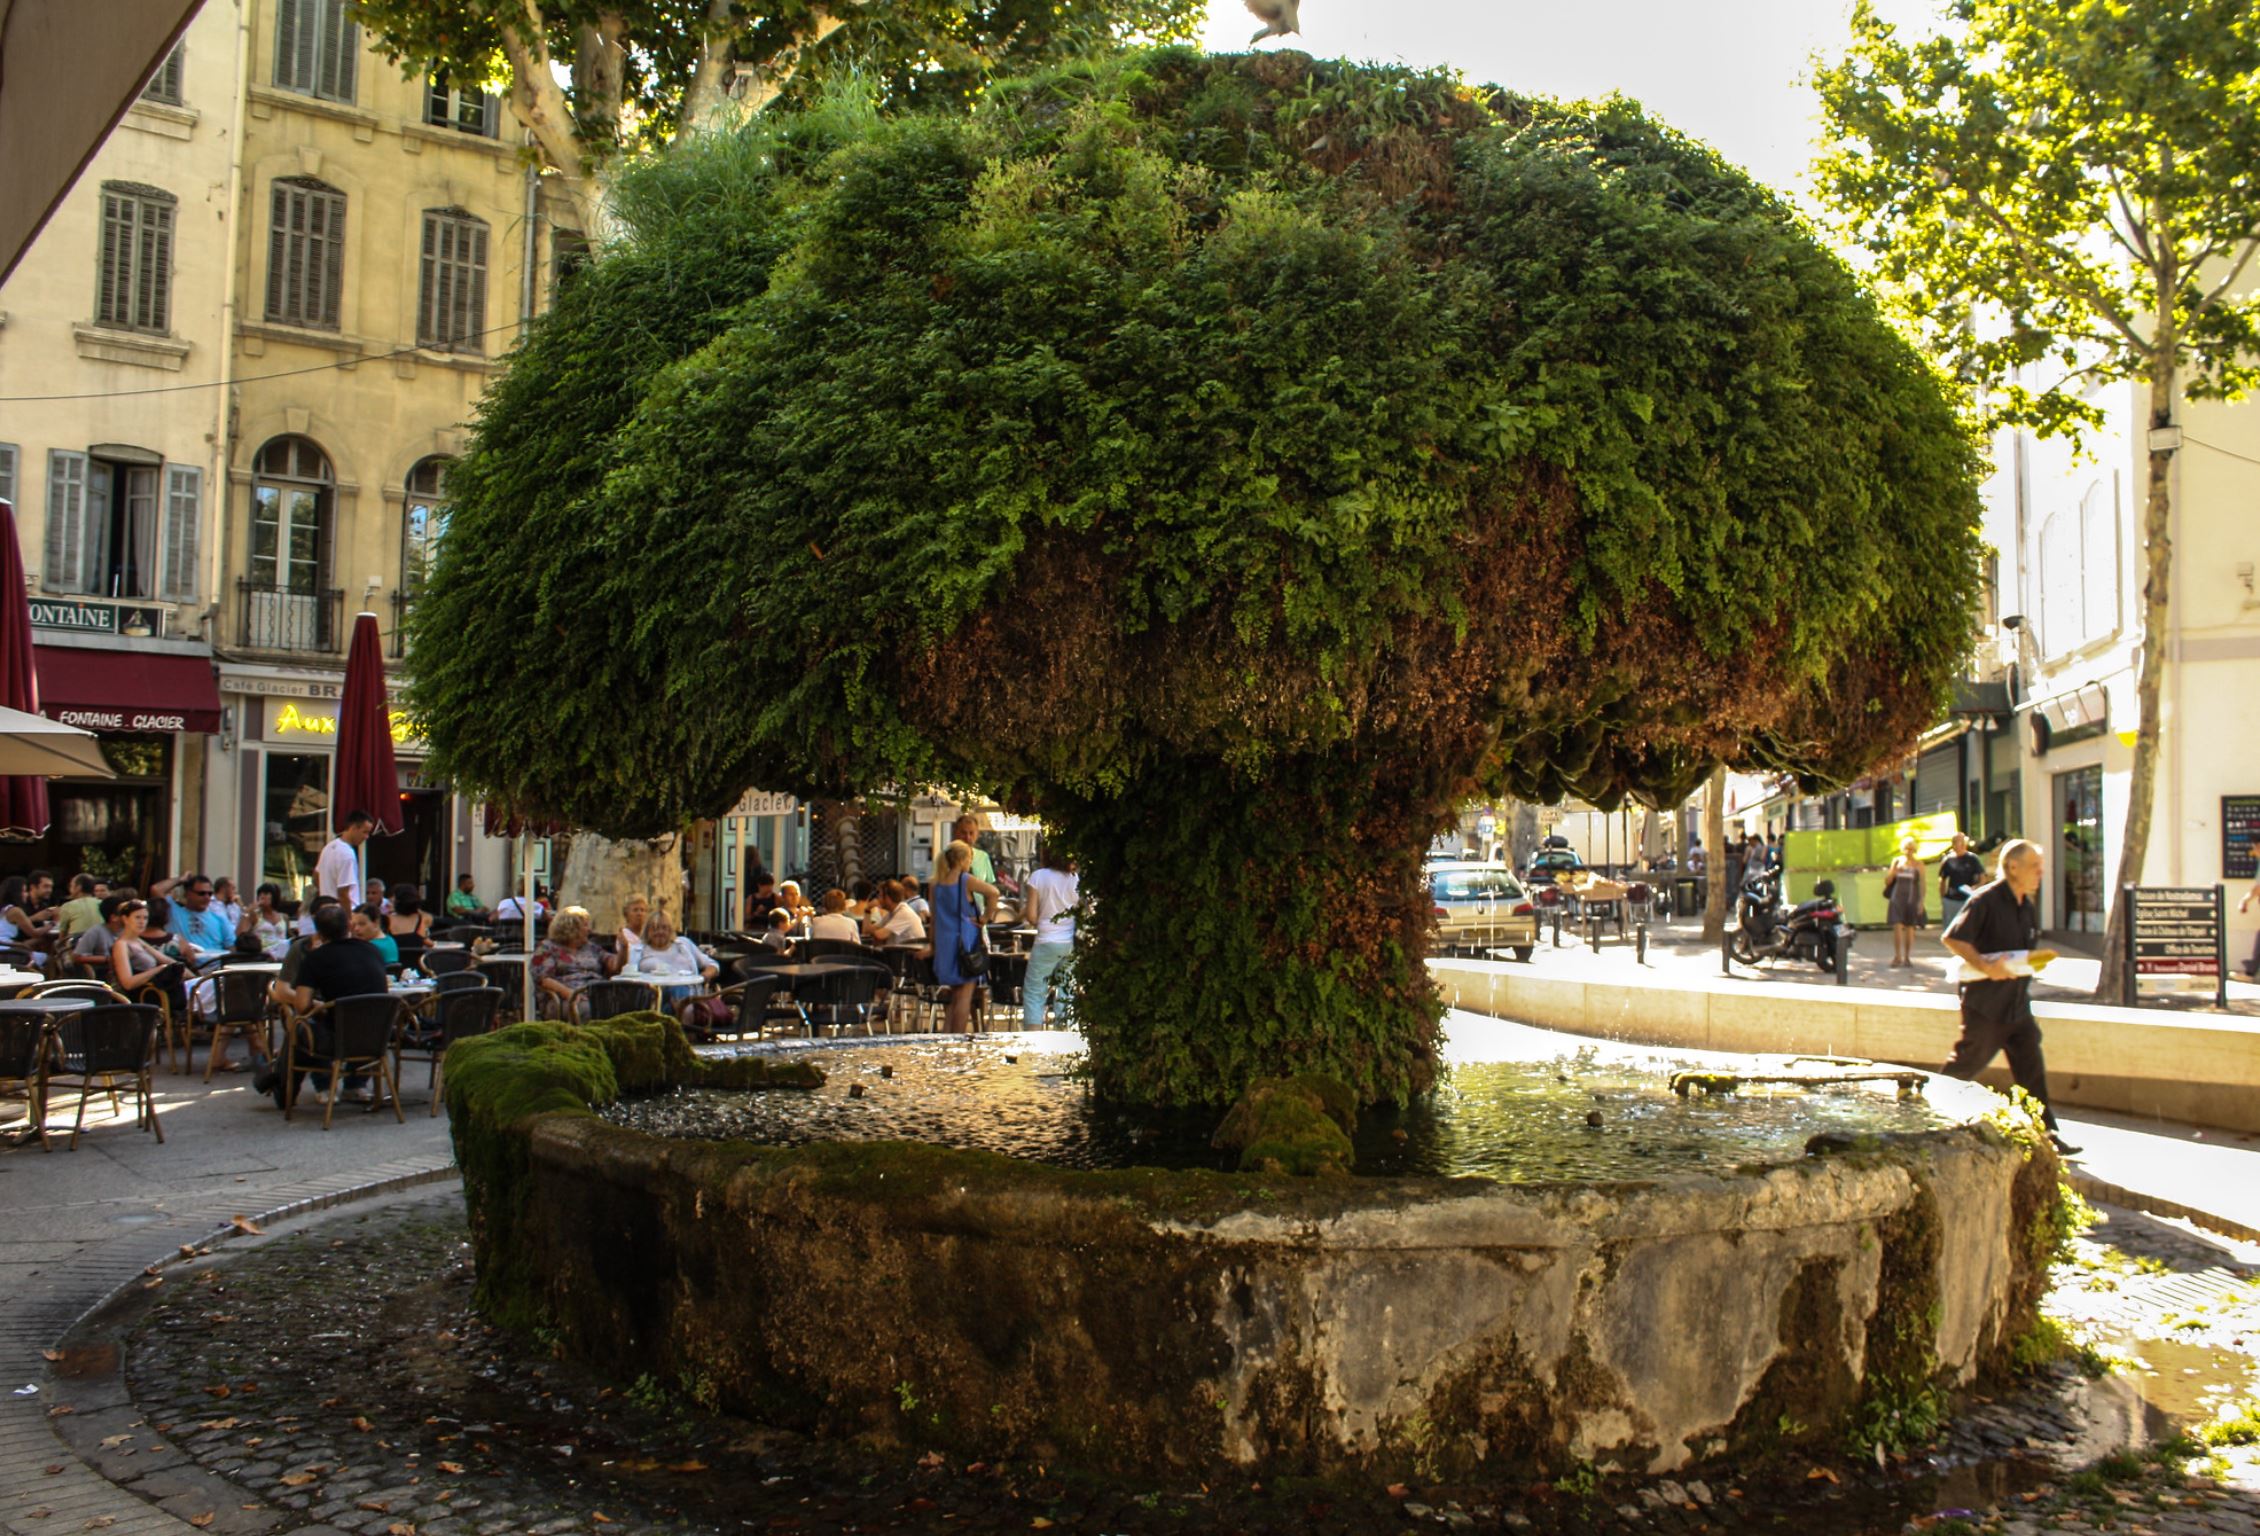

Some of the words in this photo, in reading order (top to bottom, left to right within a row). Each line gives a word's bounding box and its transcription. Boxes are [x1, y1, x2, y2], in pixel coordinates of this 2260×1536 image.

[29, 603, 110, 627] ONTAINE
[257, 682, 304, 696] Glacier
[59, 710, 123, 728] FONTAINE
[132, 714, 185, 730] GLACIER
[276, 704, 336, 735] Aux
